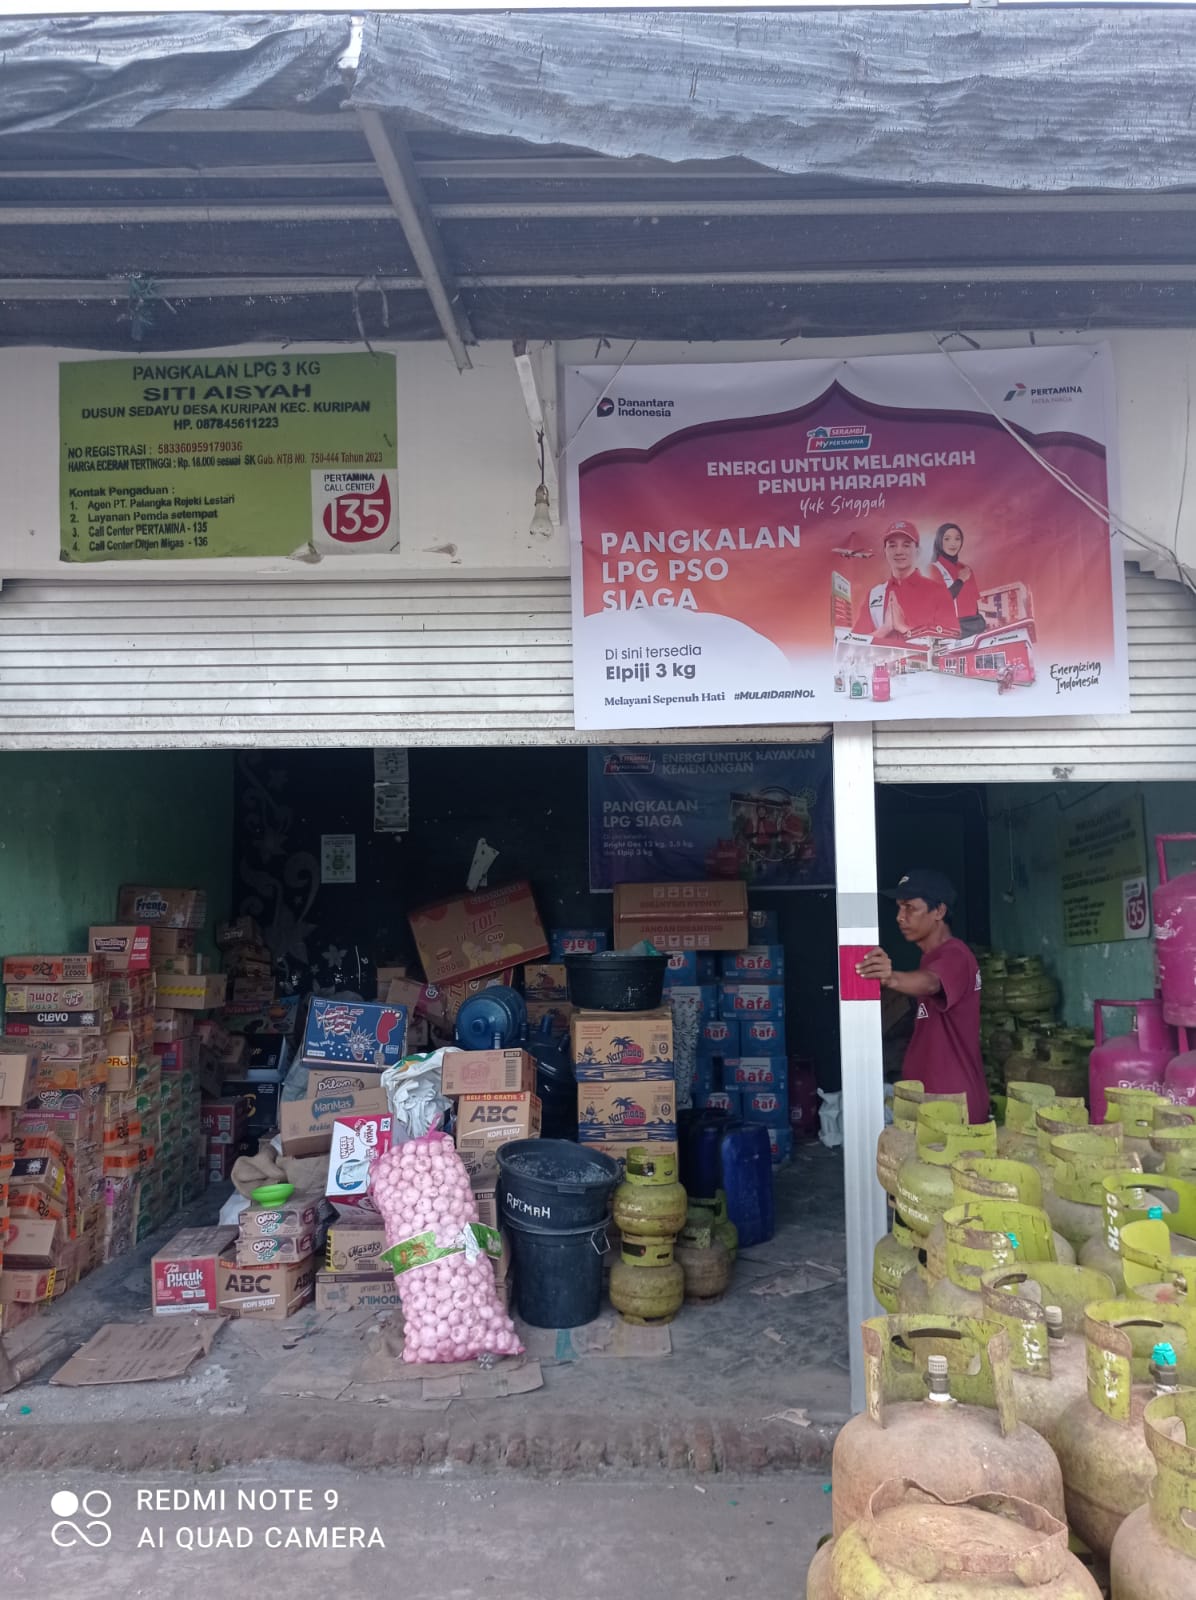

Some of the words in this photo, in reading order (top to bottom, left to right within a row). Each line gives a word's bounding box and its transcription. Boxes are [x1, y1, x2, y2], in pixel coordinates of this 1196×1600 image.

[133, 363, 238, 380] PANGKALAN
[243, 362, 277, 379] LPG
[282, 361, 291, 377] 3
[296, 360, 321, 376] KG
[143, 386, 195, 402] SITI
[203, 384, 311, 400] AISYAH
[1031, 385, 1082, 396] PERTAMINA
[82, 406, 126, 419] DUSUN
[129, 405, 180, 417] SEDAYU
[183, 404, 218, 416] DESA
[221, 402, 277, 415] KURIPAN
[280, 401, 309, 413] KEC.
[313, 400, 370, 413] KURIPAN
[617, 397, 674, 407] Danantara
[617, 407, 671, 417] Indonesia
[174, 419, 193, 431] HP.
[196, 417, 279, 430] 087845611223
[831, 427, 864, 436] SERAMBI
[68, 447, 83, 459] NO
[85, 444, 147, 458] REGISTRASI
[815, 438, 865, 449] MyPERTAMINA
[68, 460, 96, 473] HARGA
[96, 458, 129, 472] ECERAN
[131, 457, 172, 470] TERTINGGI
[178, 457, 191, 470] Rp.
[192, 456, 215, 468] 18.000
[217, 455, 241, 467] sesuai
[244, 454, 256, 465] SK
[277, 453, 293, 465] NTB
[341, 452, 364, 463] Tahun
[365, 451, 383, 462] 2023
[707, 460, 776, 476] ENERGI
[781, 456, 849, 474] UNTUK
[854, 450, 976, 470] MELANGKAH
[324, 473, 375, 482] PERTAMINA
[758, 477, 825, 494] PENUH
[831, 472, 926, 490] HARAPAN
[69, 488, 106, 498] Kontak
[108, 486, 168, 498] Pengaduan
[324, 483, 344, 492] CALL
[345, 482, 375, 491] CENTER
[70, 500, 78, 510] 1.
[88, 499, 111, 511] Agen
[113, 499, 127, 509] PT.
[129, 498, 172, 510] Palangka
[174, 496, 202, 508] Rejeki
[204, 494, 235, 505] Lestari
[799, 498, 824, 518] Yuk
[831, 492, 885, 517] Singgah
[70, 513, 79, 524] 2.
[88, 513, 131, 525] Layanan
[133, 511, 168, 521] Pemda
[170, 509, 218, 522] setempat
[329, 498, 385, 535] 135
[72, 528, 80, 538] 3.
[88, 526, 105, 537] Call
[106, 524, 134, 536] Center
[135, 523, 186, 536] PERTAMINA
[193, 521, 208, 533] 135
[72, 541, 80, 551] 4.
[89, 540, 105, 552] Call
[106, 539, 134, 551] Center
[160, 538, 184, 550] Migas
[601, 525, 801, 555] PANGKALAN
[602, 560, 658, 584] LPG
[669, 557, 729, 581] PSO
[602, 588, 698, 612] SIAGA
[605, 648, 615, 660] Di
[617, 646, 642, 659] sini
[646, 644, 702, 658] tersedia
[606, 662, 650, 682] Elpiji
[655, 663, 667, 678] 3
[673, 662, 696, 679] kg
[1050, 661, 1101, 680] Energizing
[1055, 674, 1099, 694] Indonesia
[604, 694, 651, 707] Melayani
[653, 693, 699, 706] Sepenuh
[702, 691, 725, 702] Hati
[734, 689, 815, 701] #MULAIDARINOL
[662, 752, 705, 764] ENERGI
[709, 751, 752, 763] UNTUK
[755, 748, 816, 760] RAYAKAN
[662, 763, 754, 775] KEMENANGAN
[603, 799, 699, 813] PANGKALAN
[603, 815, 631, 828] LPG
[636, 814, 683, 828] SIAGA
[735, 955, 772, 969] Rafa
[734, 997, 772, 1009] Rafa
[704, 1027, 730, 1038] Rafa
[750, 1027, 777, 1038] Rafa
[606, 1048, 642, 1064] Narmada
[735, 1070, 774, 1082] Rafa
[318, 1080, 351, 1090] Dilan
[752, 1099, 779, 1109] Rafa
[470, 1105, 518, 1123] ABC
[608, 1110, 645, 1125] Narmada
[166, 1269, 204, 1288] pucuk
[224, 1274, 272, 1293] ABC
[358, 1295, 402, 1305] NDOMILK
